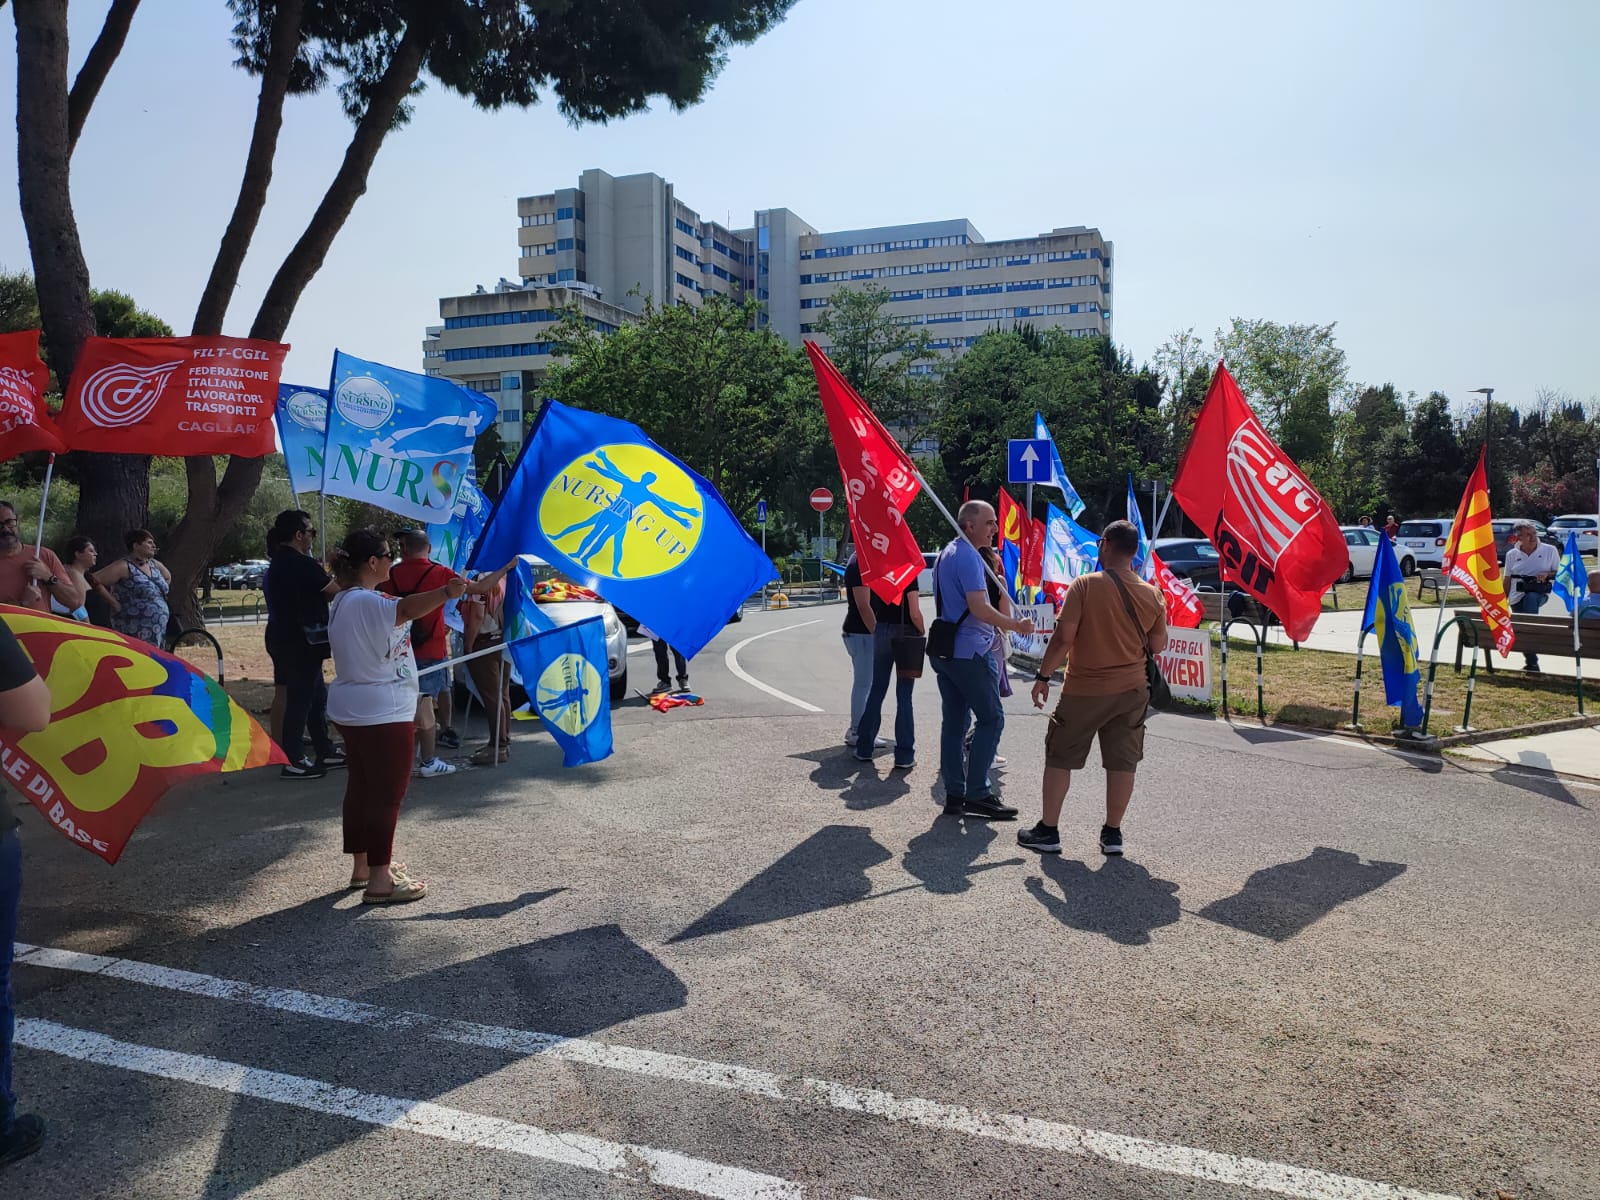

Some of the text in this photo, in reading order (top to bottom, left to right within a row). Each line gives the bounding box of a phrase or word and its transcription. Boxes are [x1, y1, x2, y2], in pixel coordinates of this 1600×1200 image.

[193, 347, 270, 361] FILT-CGIL
[188, 366, 269, 381] FEDERAZIONE
[188, 378, 246, 391] ITALIANA
[186, 389, 265, 404] LAVORATORI
[185, 401, 257, 417] TRASPORTI
[553, 474, 688, 556] NURSING UP
[1451, 565, 1501, 618] SINDACALE
[1169, 638, 1187, 655] PER
[26, 776, 55, 804] DI
[48, 801, 110, 853] BASE
